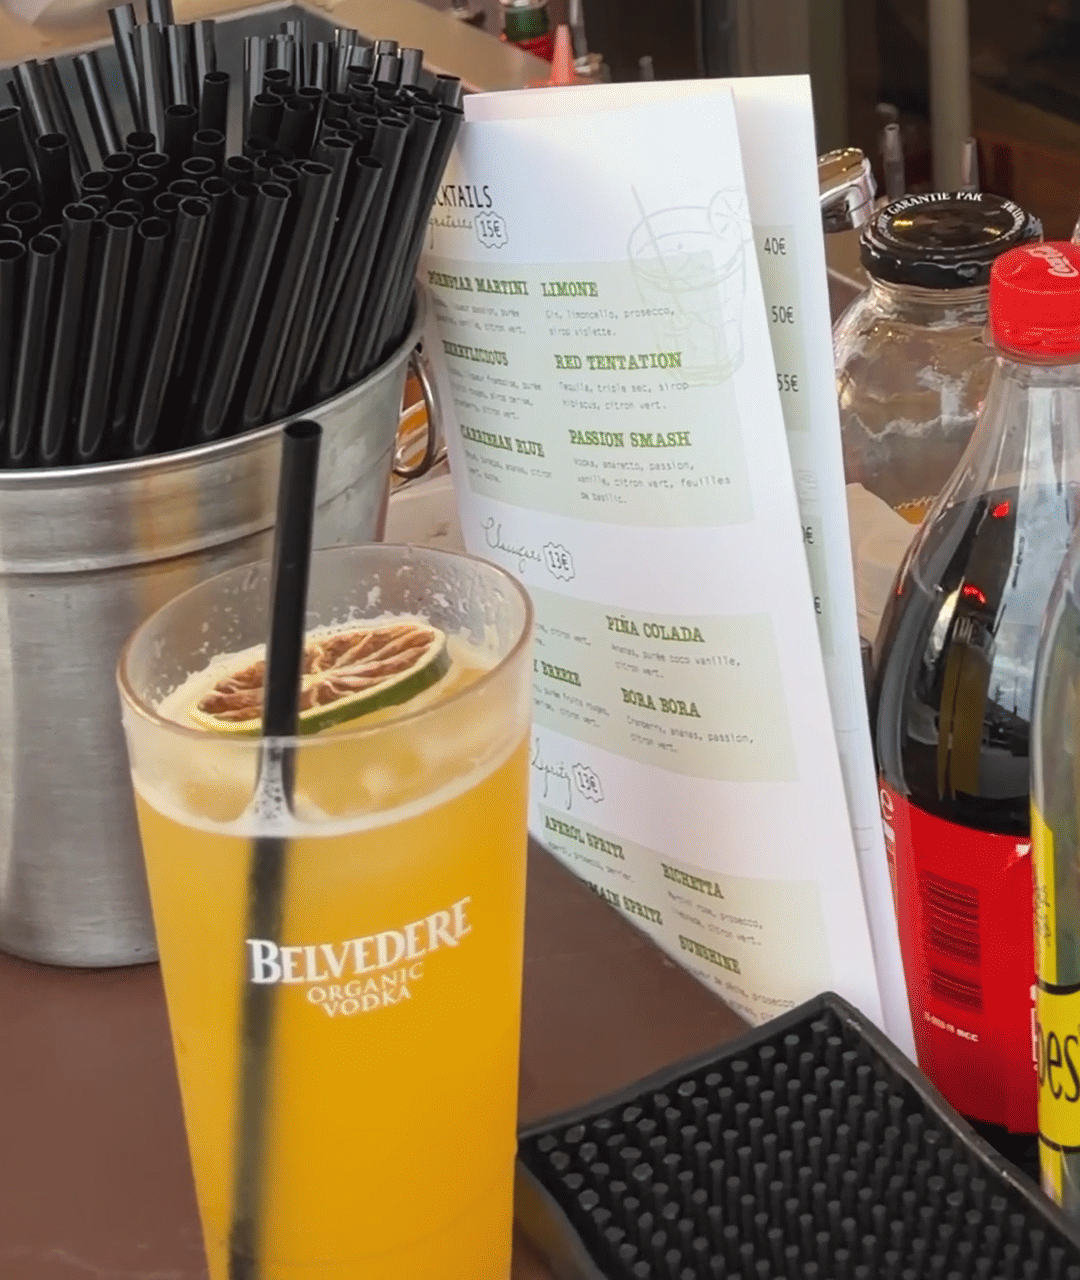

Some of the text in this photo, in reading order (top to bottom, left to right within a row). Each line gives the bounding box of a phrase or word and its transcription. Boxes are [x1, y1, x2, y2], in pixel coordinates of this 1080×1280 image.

[886, 191, 951, 215] GARANTIE
[479, 219, 502, 239] 15€
[764, 237, 787, 256] 40€
[474, 277, 529, 296] MARTINI
[541, 281, 599, 297] LIMONE
[623, 307, 675, 319] prosecco,
[771, 305, 795, 324] 50€
[554, 351, 682, 371] RED TENTATION
[568, 429, 693, 449] PASSION SMASH
[605, 614, 640, 637] PIÑA
[642, 622, 706, 643] COLADA
[620, 687, 657, 712] BORA
[658, 697, 702, 719] BORA
[585, 831, 626, 861] SPRITZ
[246, 896, 472, 985] BELVEDERE
[306, 961, 425, 1005] ORGANIC
[322, 984, 413, 1018] VODKA
